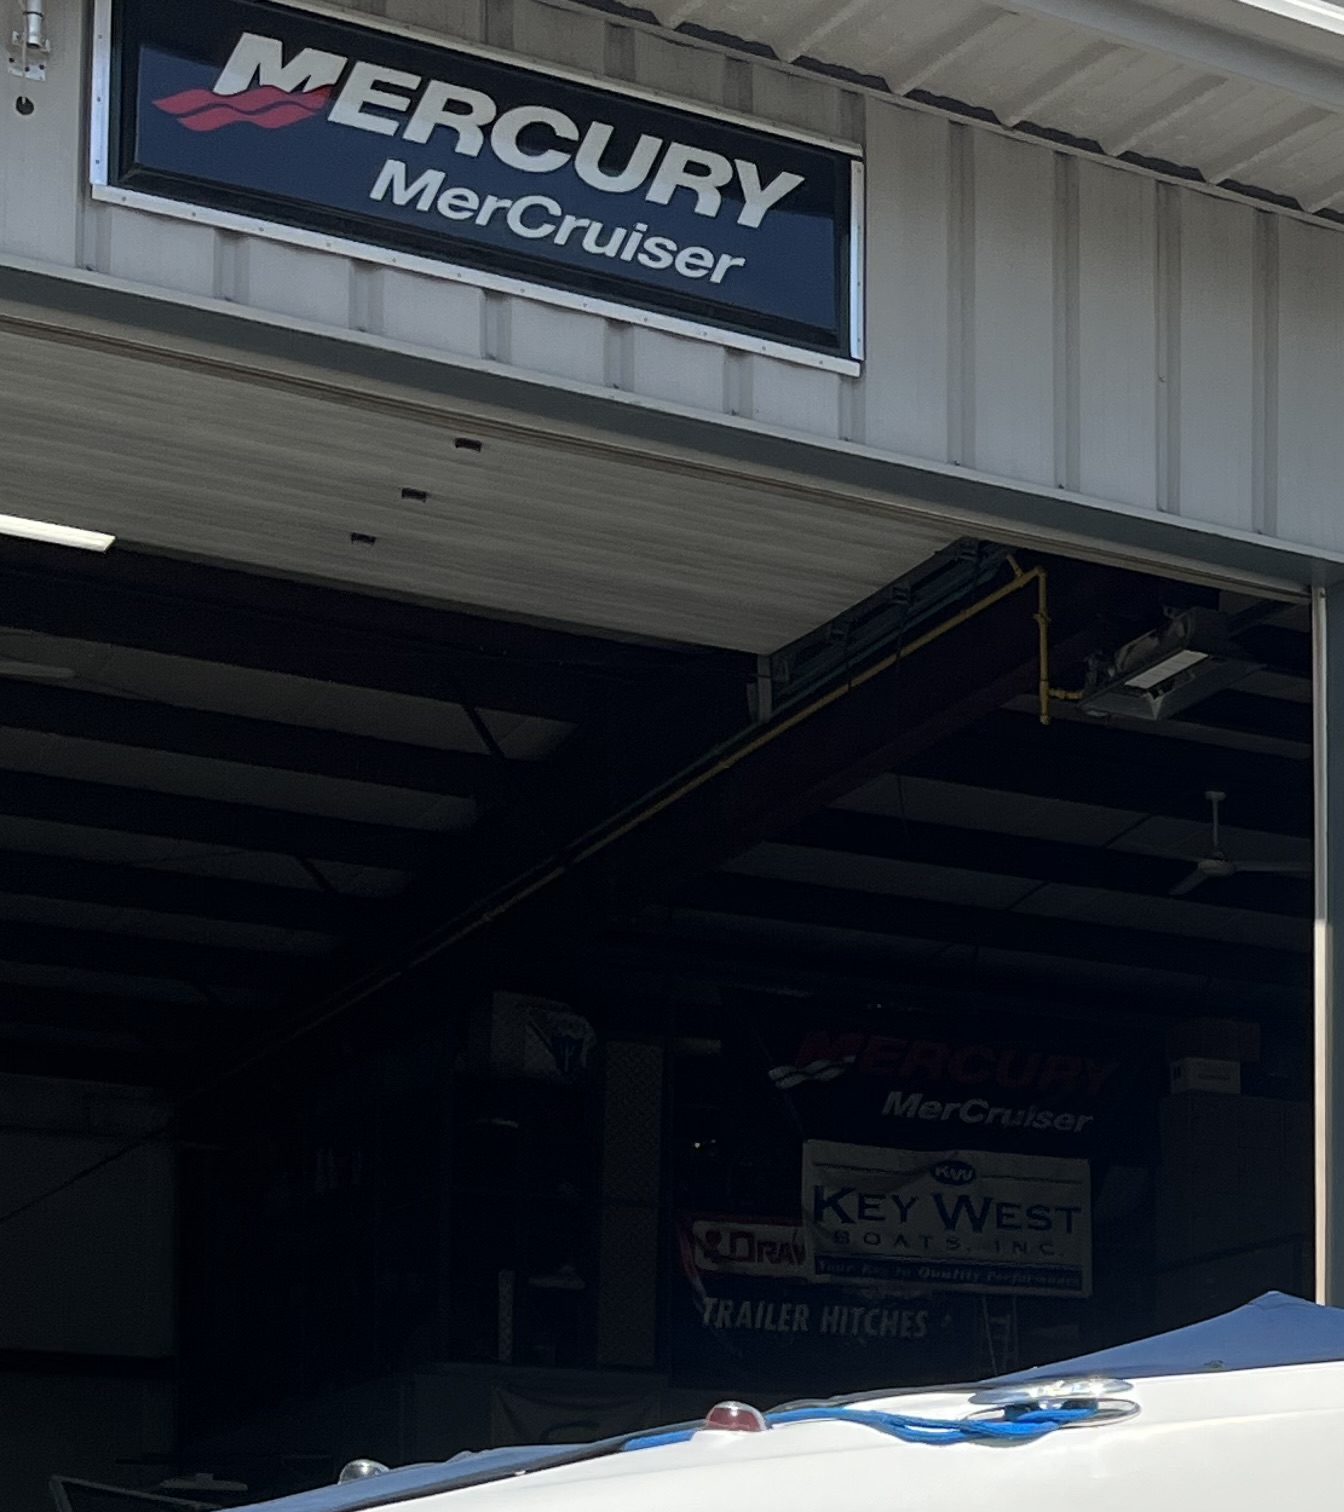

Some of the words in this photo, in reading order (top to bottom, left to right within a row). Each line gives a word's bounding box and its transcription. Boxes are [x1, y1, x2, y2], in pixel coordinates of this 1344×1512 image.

[212, 32, 804, 229] MERCURY
[369, 159, 745, 285] MerCruiser
[793, 1028, 1119, 1096] MERCURY
[881, 1091, 1094, 1133] MerCruiser
[703, 1296, 810, 1333] TRAILER
[820, 1305, 930, 1339] HITCHES
